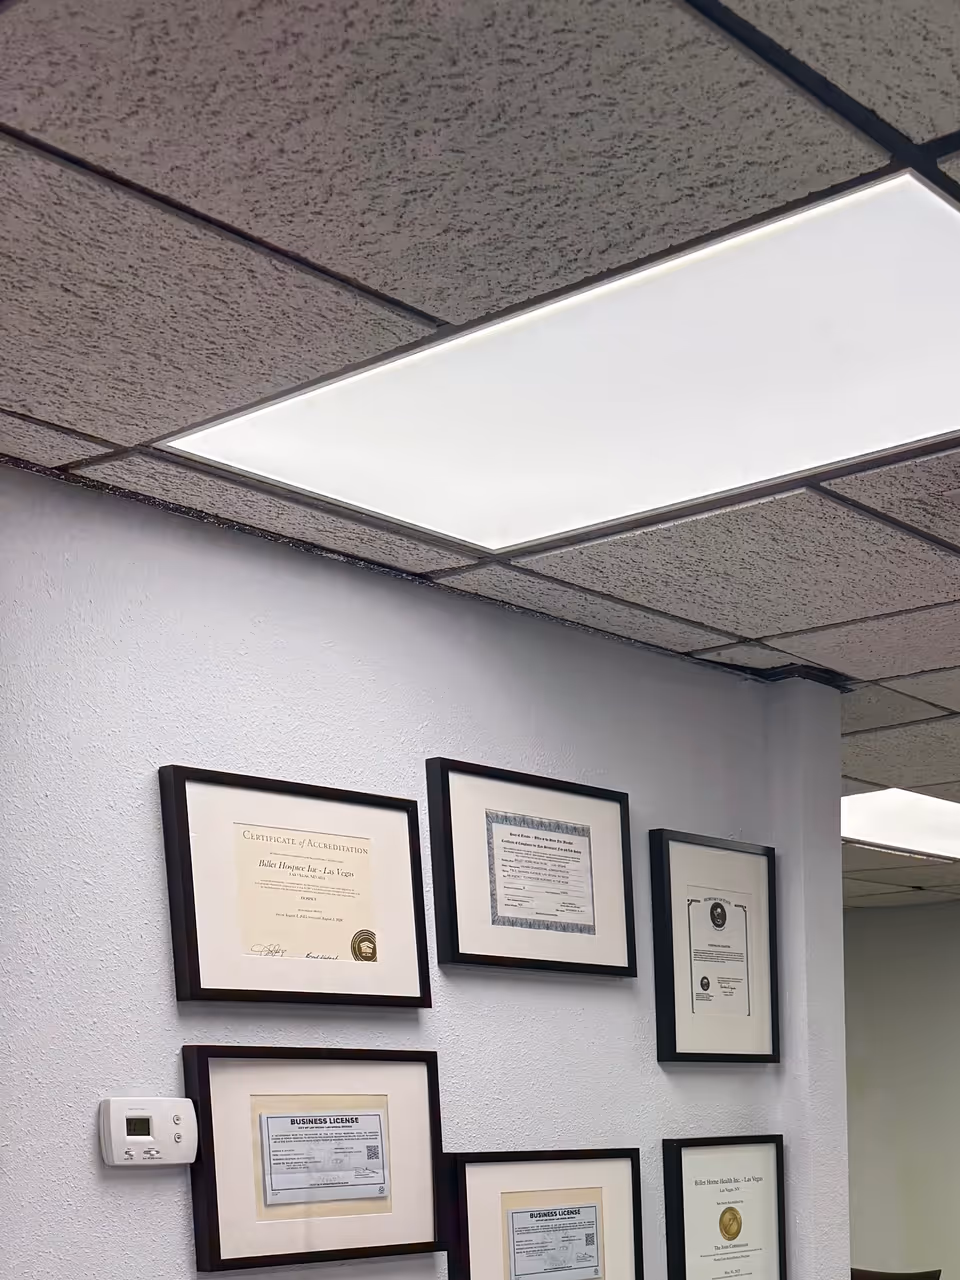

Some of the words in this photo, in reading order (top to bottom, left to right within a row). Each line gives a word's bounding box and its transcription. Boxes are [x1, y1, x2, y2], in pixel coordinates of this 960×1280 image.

[242, 830, 296, 845] CERTIFICATE
[299, 839, 305, 848] of
[307, 839, 368, 855] ACCREDITATION
[323, 867, 335, 876] Las
[336, 868, 355, 878] Vegas
[290, 1117, 327, 1126] BUSINESS
[529, 1210, 558, 1219] BUSINESS
[558, 1209, 581, 1217] LICENSE
